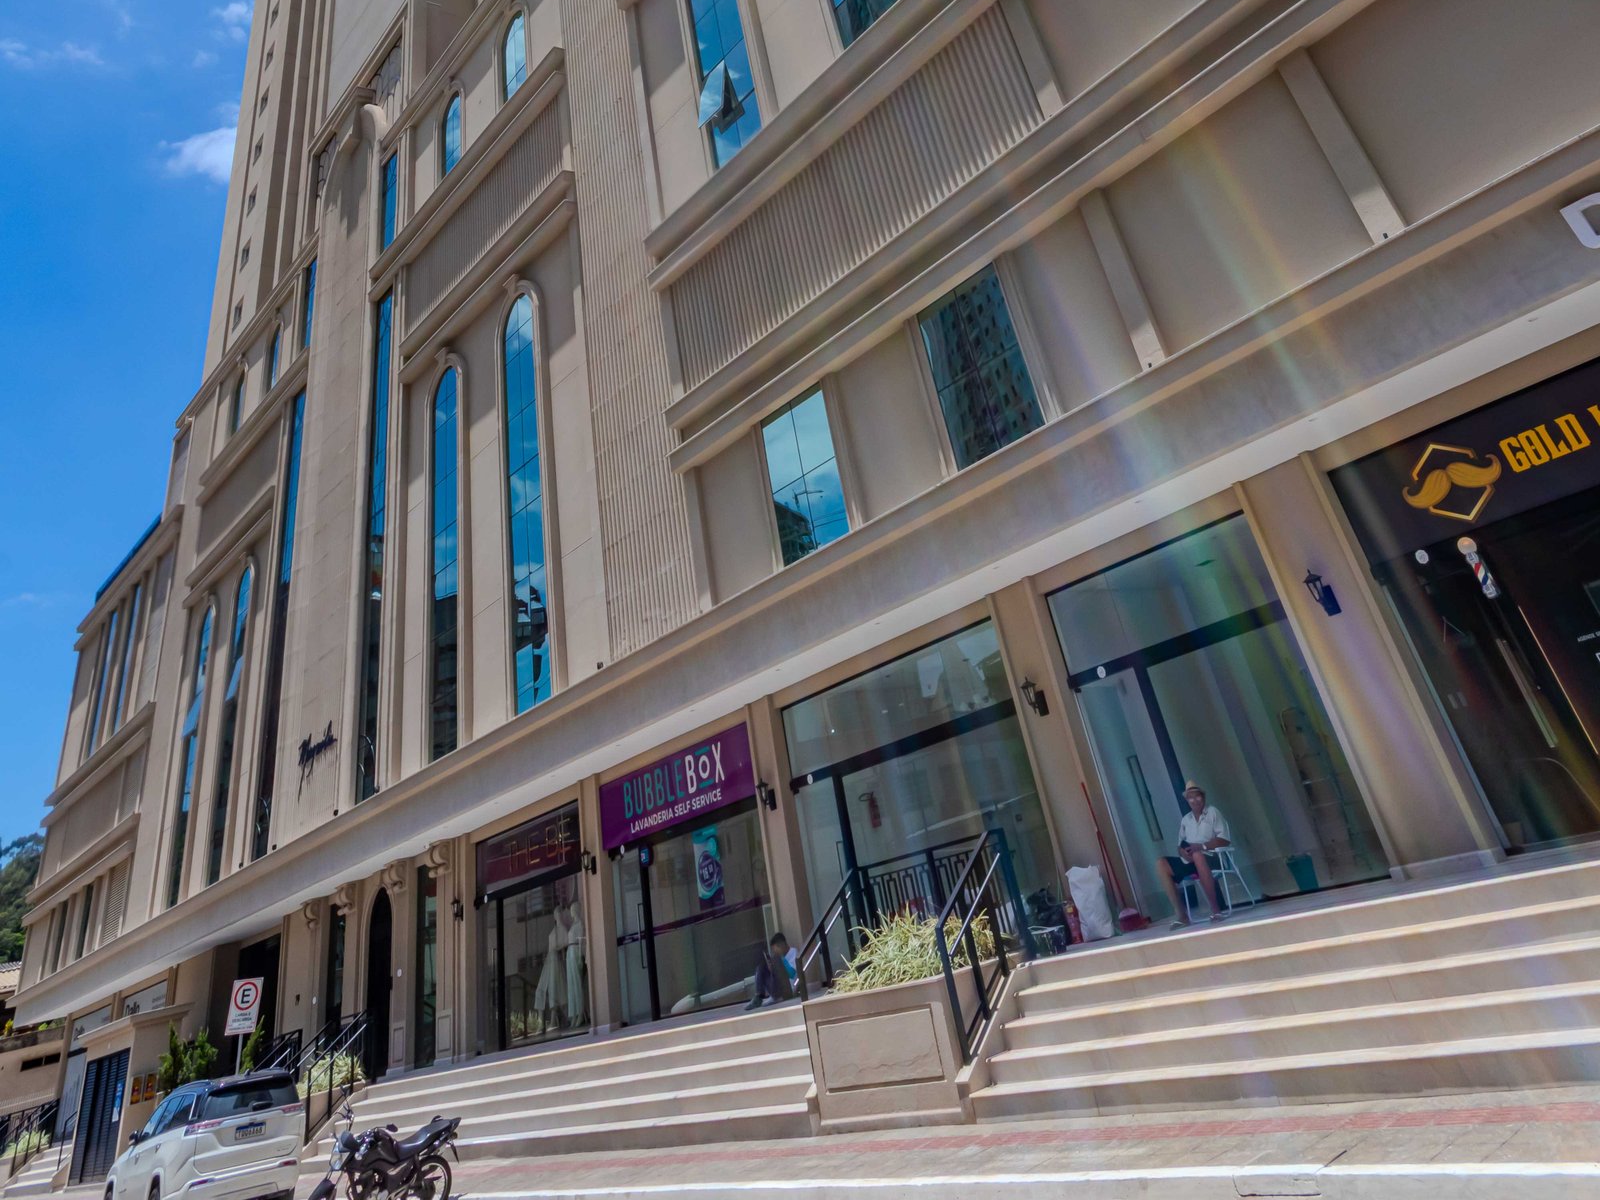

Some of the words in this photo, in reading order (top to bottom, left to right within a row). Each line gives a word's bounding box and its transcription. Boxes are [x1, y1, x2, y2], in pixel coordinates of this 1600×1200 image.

[1499, 412, 1591, 473] GOLD
[630, 807, 673, 834] LAVANDERIA
[674, 801, 691, 817] SELF
[692, 788, 722, 810] SERVICE
[240, 988, 252, 1005] E
